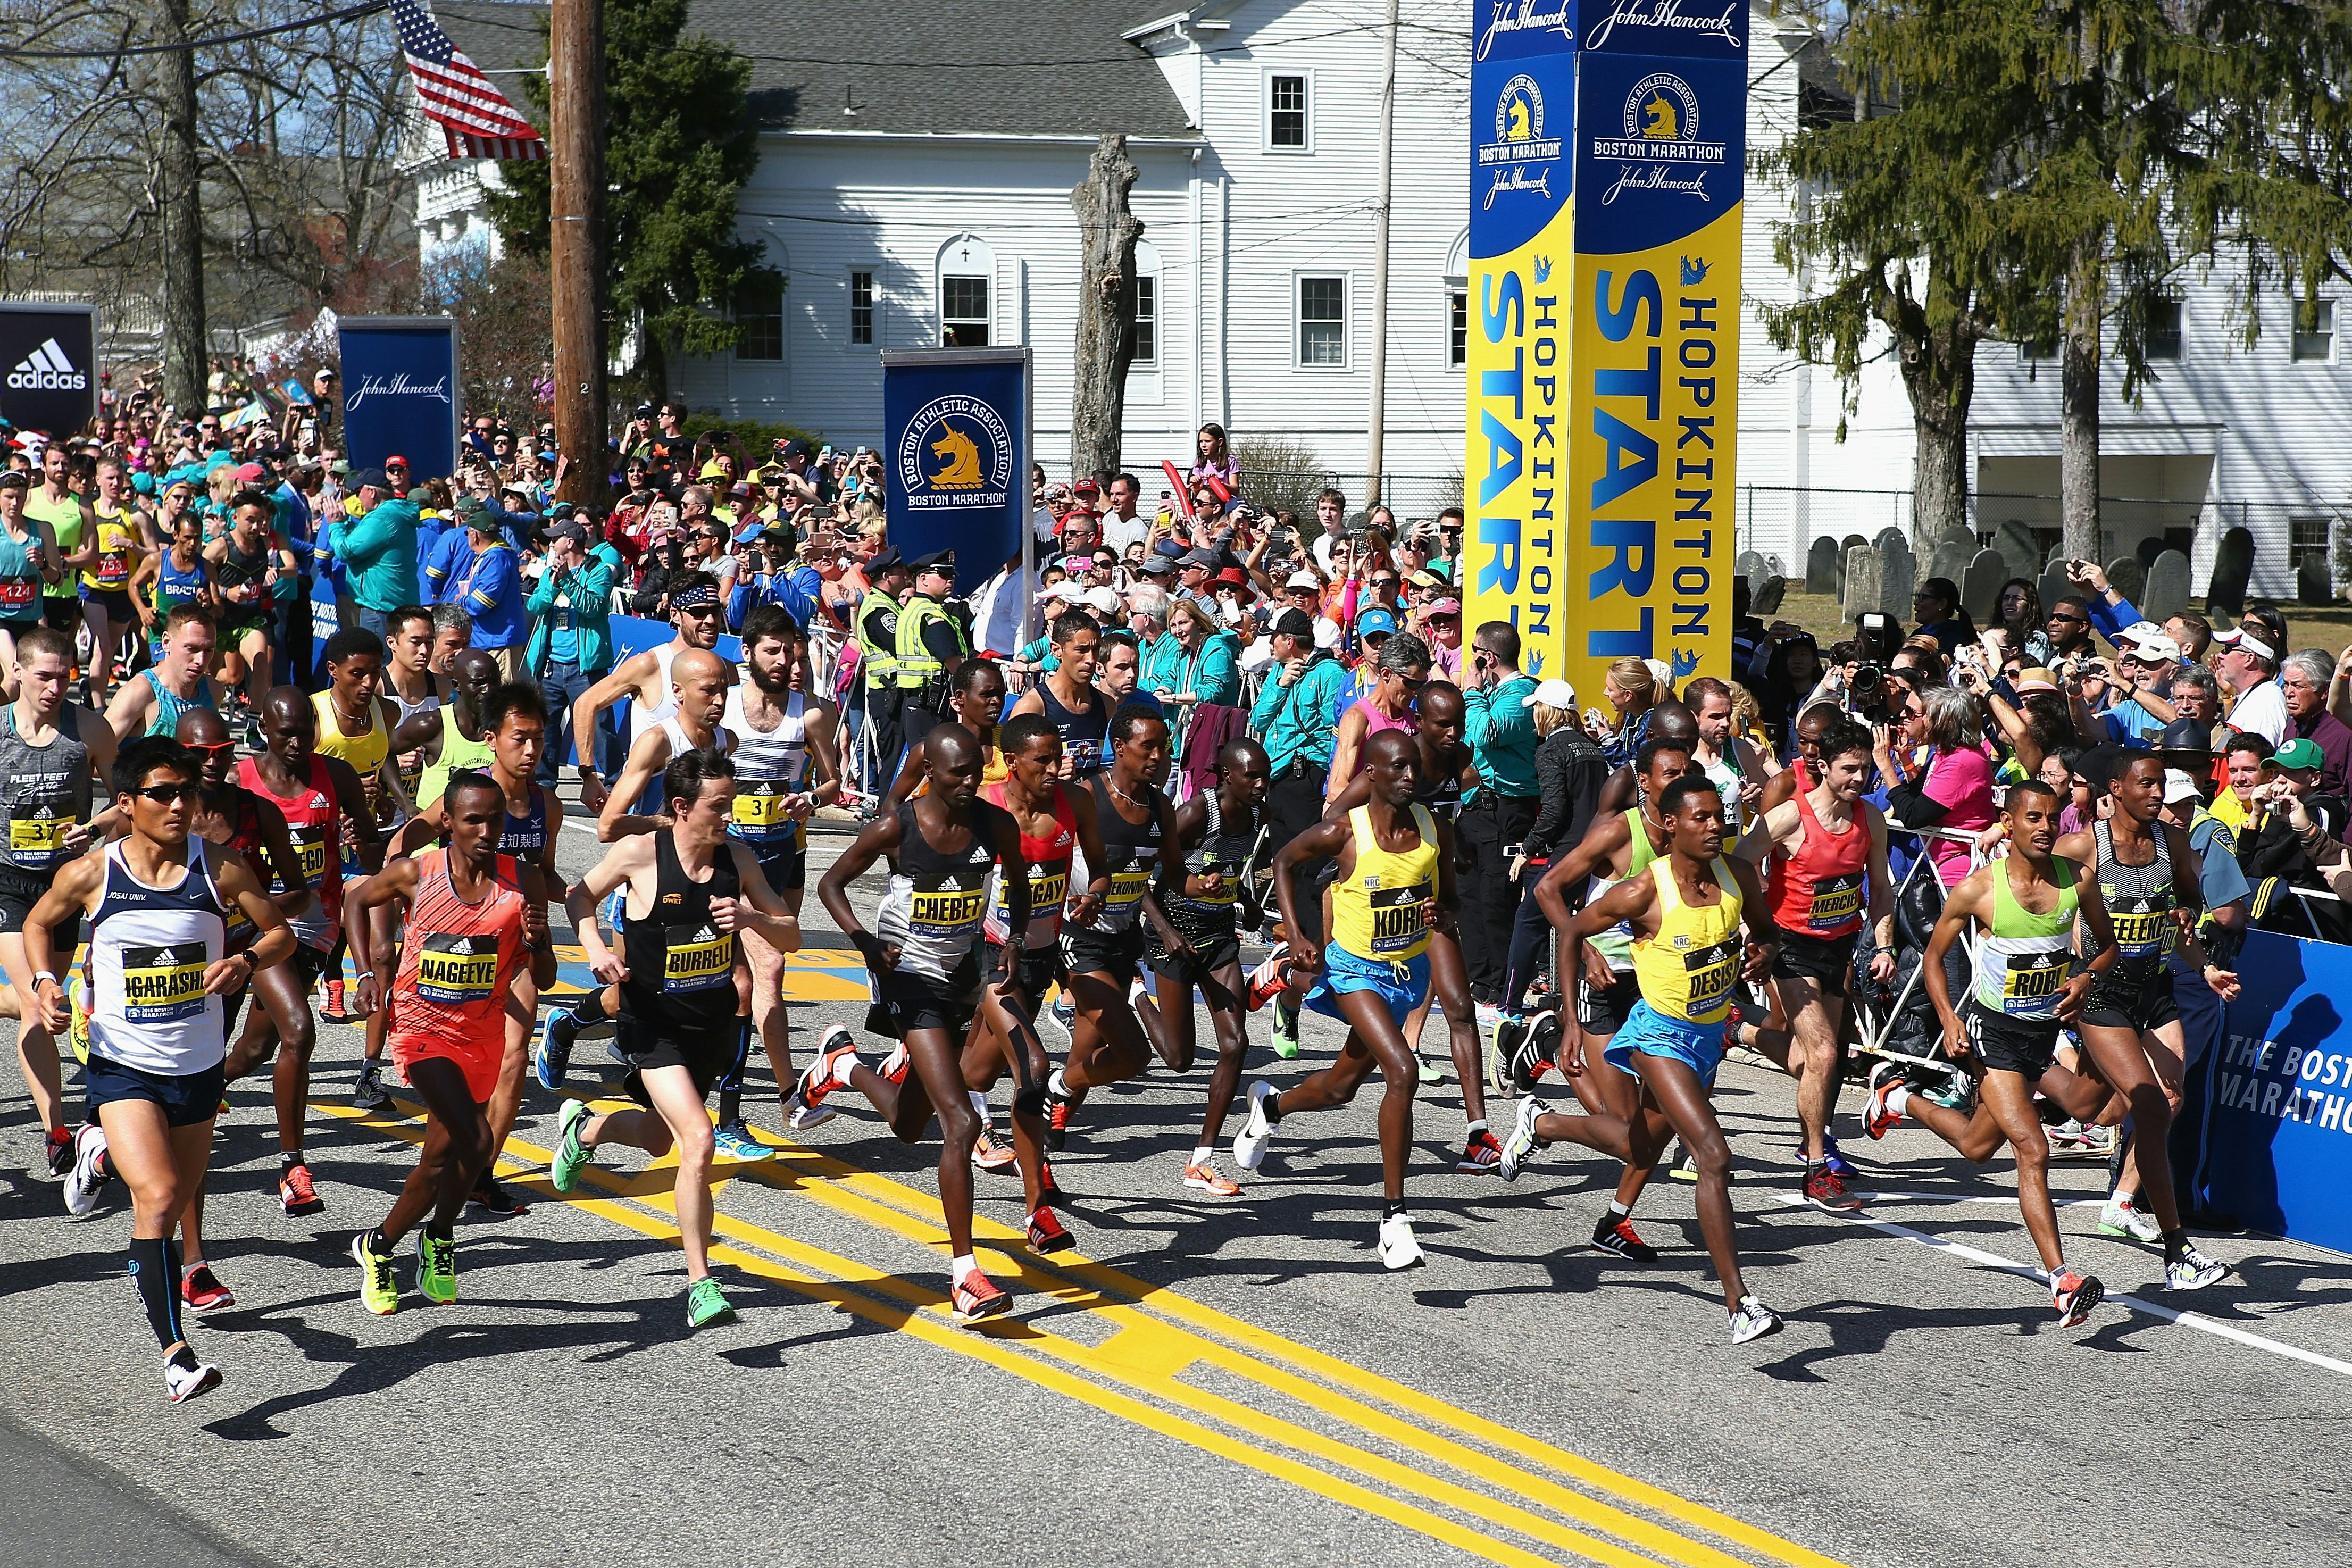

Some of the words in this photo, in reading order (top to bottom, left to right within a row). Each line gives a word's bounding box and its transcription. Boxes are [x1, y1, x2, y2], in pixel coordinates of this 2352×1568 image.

[1477, 0, 1515, 62] John
[1514, 0, 1573, 40] Hancock
[1586, 0, 1648, 50] John
[1647, 0, 1741, 47] Hancock
[1497, 101, 1506, 137] BOSTON
[1503, 78, 1527, 102] ATHLETIC
[1526, 79, 1542, 135] ASSOCIATION
[1627, 96, 1639, 134] BOSTON
[1635, 76, 1672, 97] ATHLETIC
[1672, 80, 1697, 136] ASSOCIATION
[1479, 146, 1510, 162] BOSTON
[1513, 142, 1559, 159] MARATHON
[1594, 141, 1645, 156] BOSTON
[1650, 144, 1724, 160] MARATHON
[1483, 169, 1511, 211] John
[1510, 165, 1552, 198] Hancock
[1601, 164, 1649, 205] John
[1646, 164, 1711, 202] Hancock
[7, 370, 86, 389] adidas
[346, 374, 388, 411] John
[387, 373, 451, 403] Hancock
[580, 382, 588, 394] 2
[904, 431, 920, 485] BOSTON
[914, 399, 969, 432] ATHLETIC
[970, 403, 1008, 480] ASSOCIATION
[1477, 270, 1524, 633] STAR
[1529, 295, 1557, 636] HOPKINTON
[1671, 297, 1718, 637] HOPKINTON
[908, 494, 949, 506] BOSTON
[953, 492, 1005, 505] MARATHON
[99, 560, 122, 574] 753
[6, 586, 30, 597] 124
[165, 584, 196, 595] BRAZI
[10, 774, 41, 783] FLEET
[43, 772, 69, 780] FEET
[751, 799, 773, 816] 31
[32, 823, 59, 841] 37
[1002, 879, 1064, 905] TGAY
[1108, 879, 1146, 896] EKONNE
[1365, 878, 1380, 887] NRC
[913, 896, 983, 921] CHEBET
[1810, 891, 1858, 915] MERCIE
[1373, 906, 1422, 938] KORI
[1674, 937, 1690, 946] NRC
[670, 943, 731, 973] BURRELL
[421, 958, 495, 985] NAGEEYE
[2014, 969, 2060, 997] ROBI
[2225, 1034, 2278, 1071] THE
